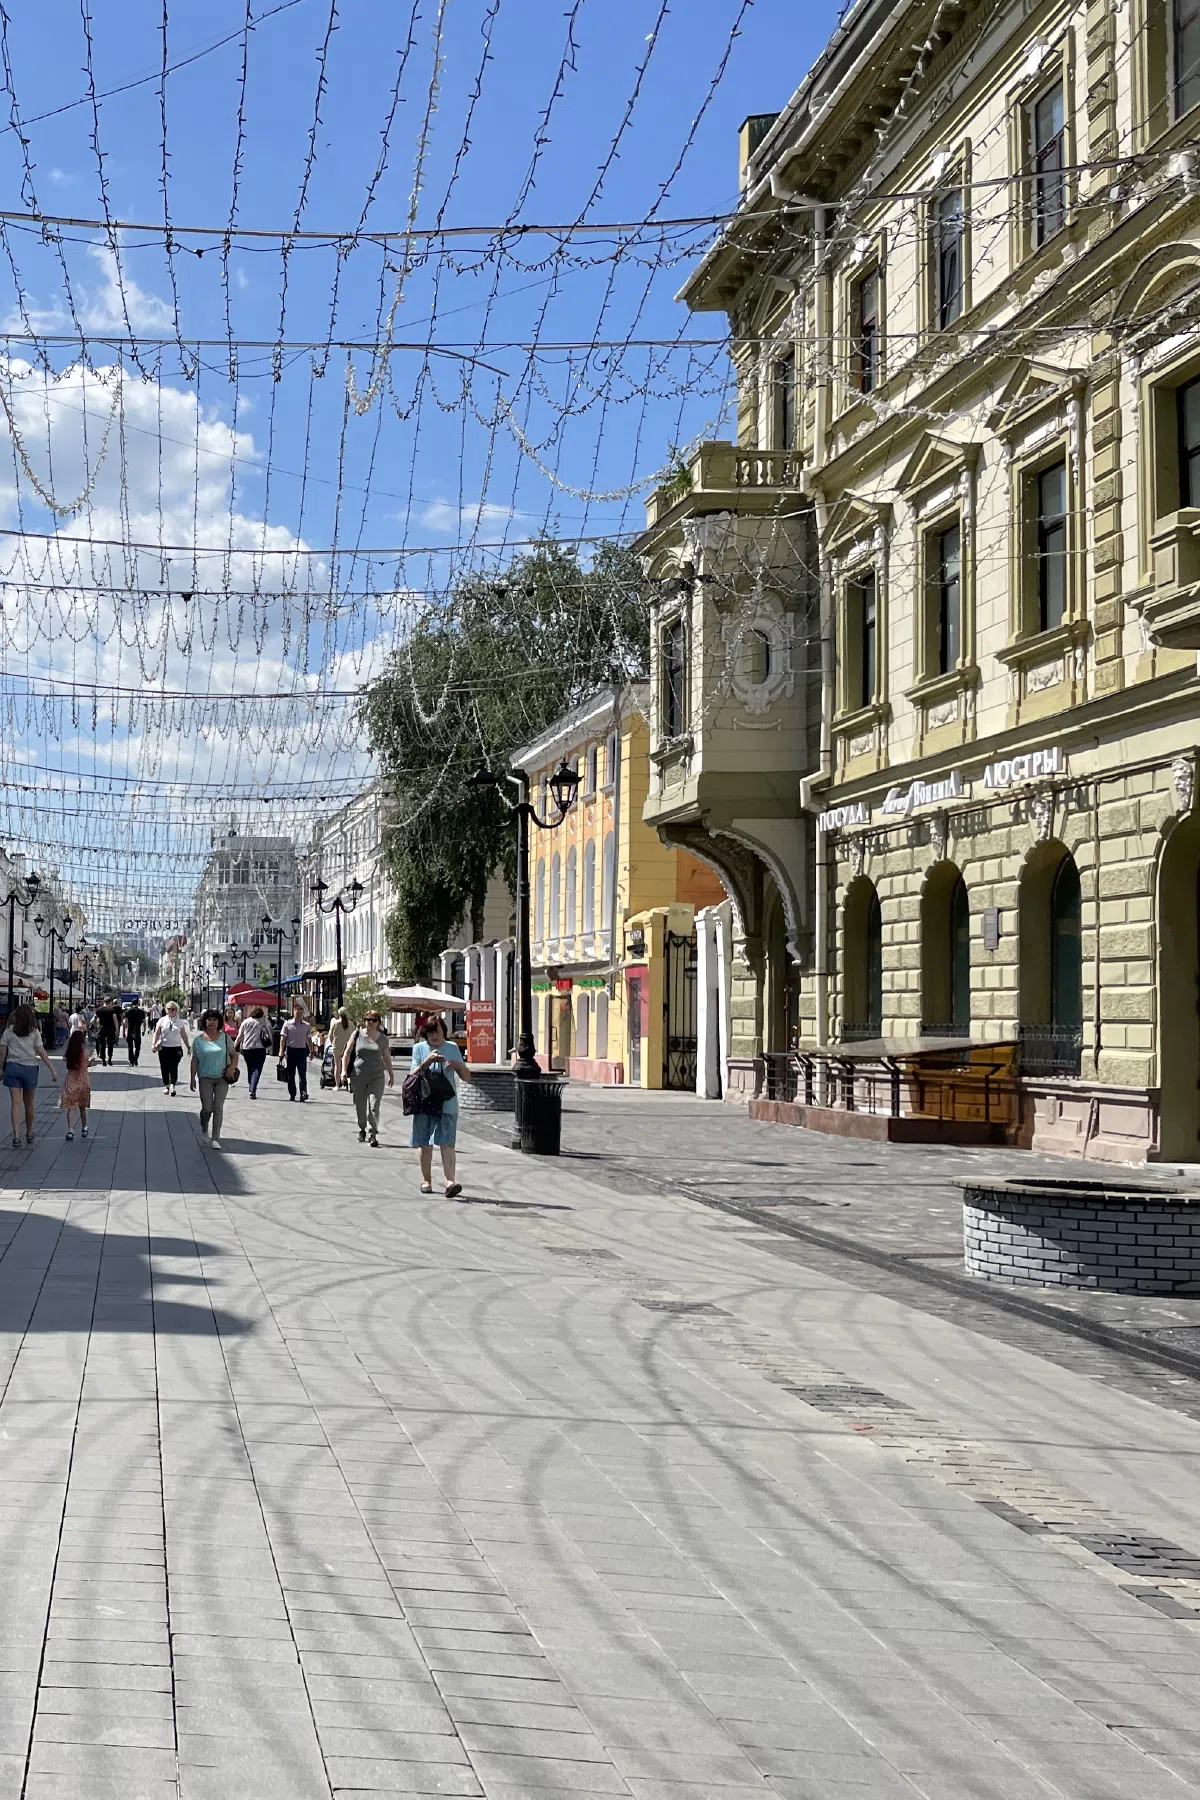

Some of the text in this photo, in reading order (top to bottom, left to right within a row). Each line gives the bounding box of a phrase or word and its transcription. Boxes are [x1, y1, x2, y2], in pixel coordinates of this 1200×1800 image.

[983, 747, 1059, 787] ЛЮСТРЫ
[819, 801, 864, 832] ПОСУДА
[471, 1005, 493, 1013] ВОДА
